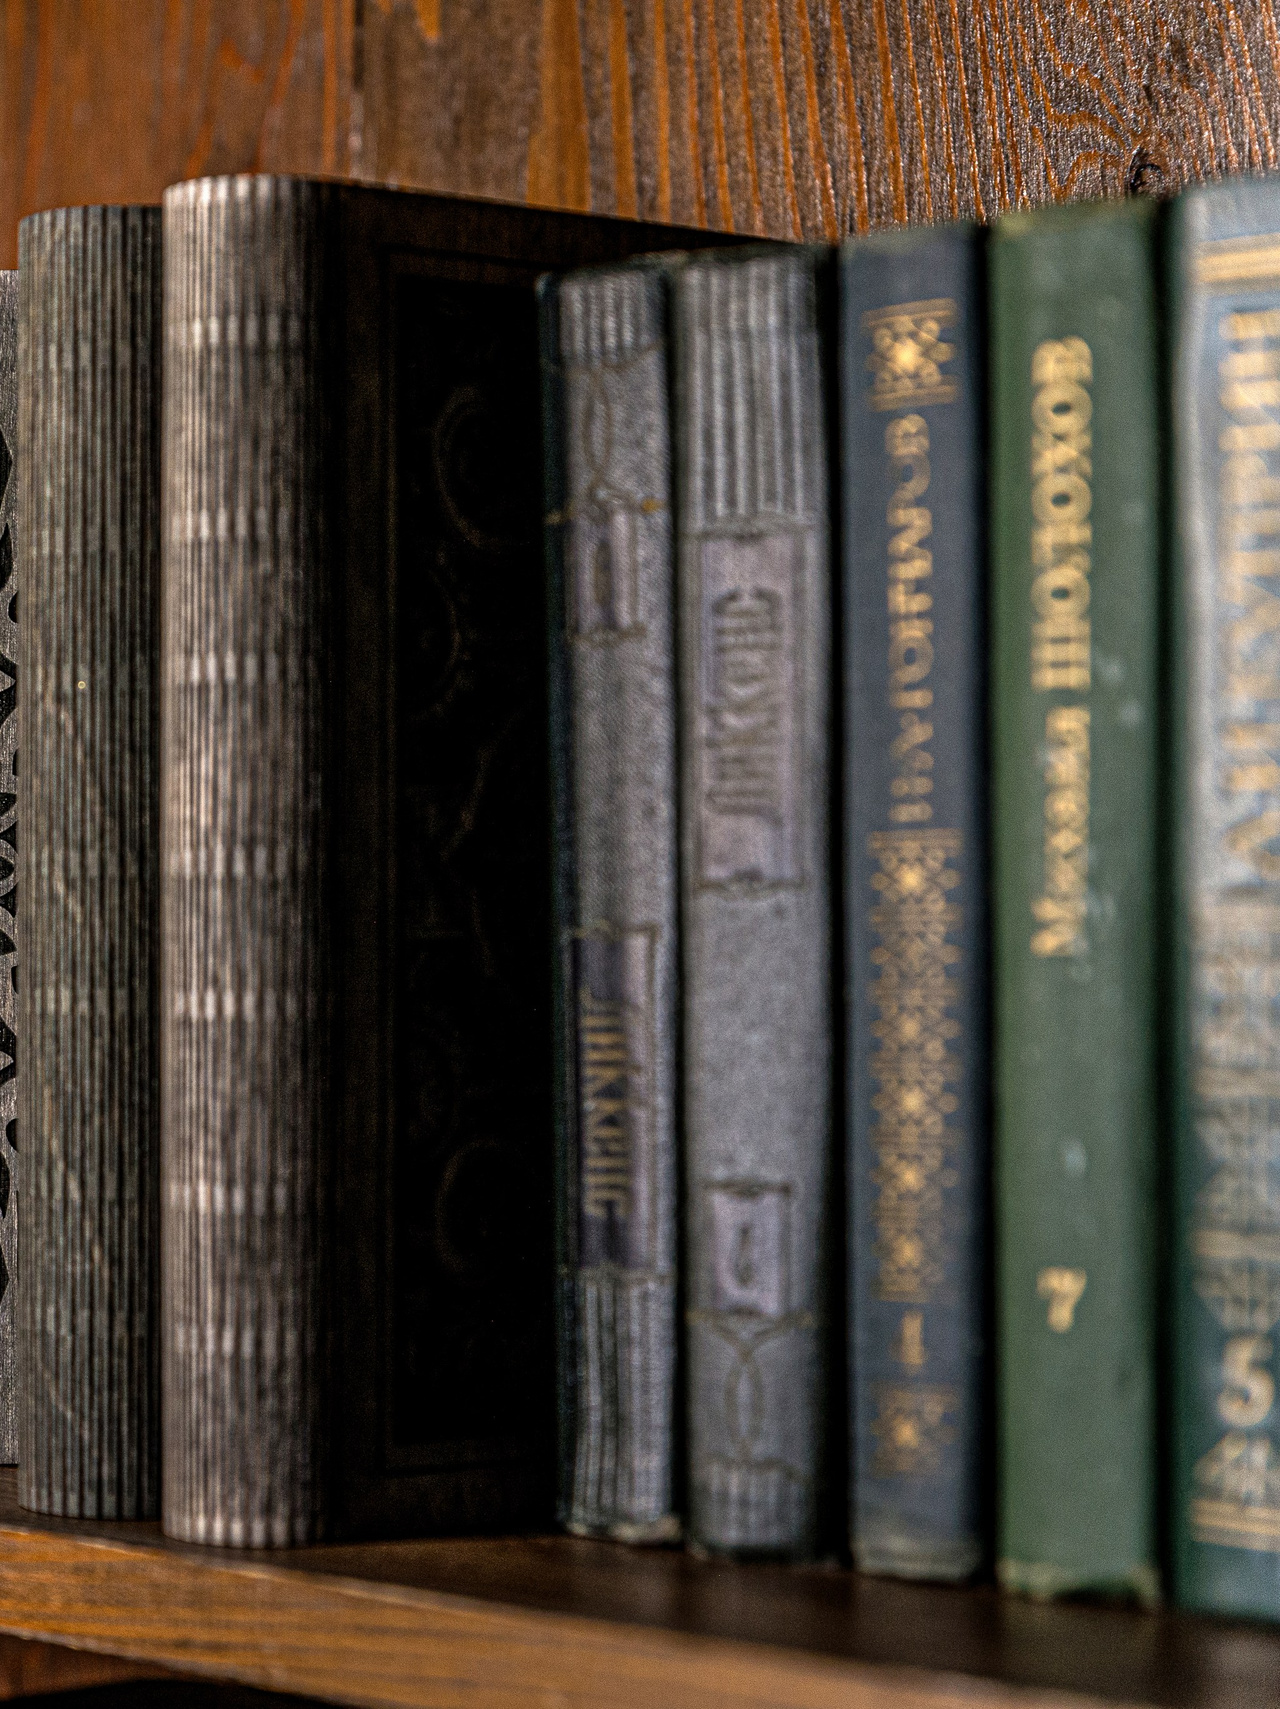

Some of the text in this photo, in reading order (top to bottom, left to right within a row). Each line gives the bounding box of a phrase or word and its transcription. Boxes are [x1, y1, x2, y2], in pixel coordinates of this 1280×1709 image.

[1031, 337, 1093, 692] ШОЛОХОВ
[1036, 1266, 1087, 1334] 7
[1217, 1334, 1275, 1428] 5
